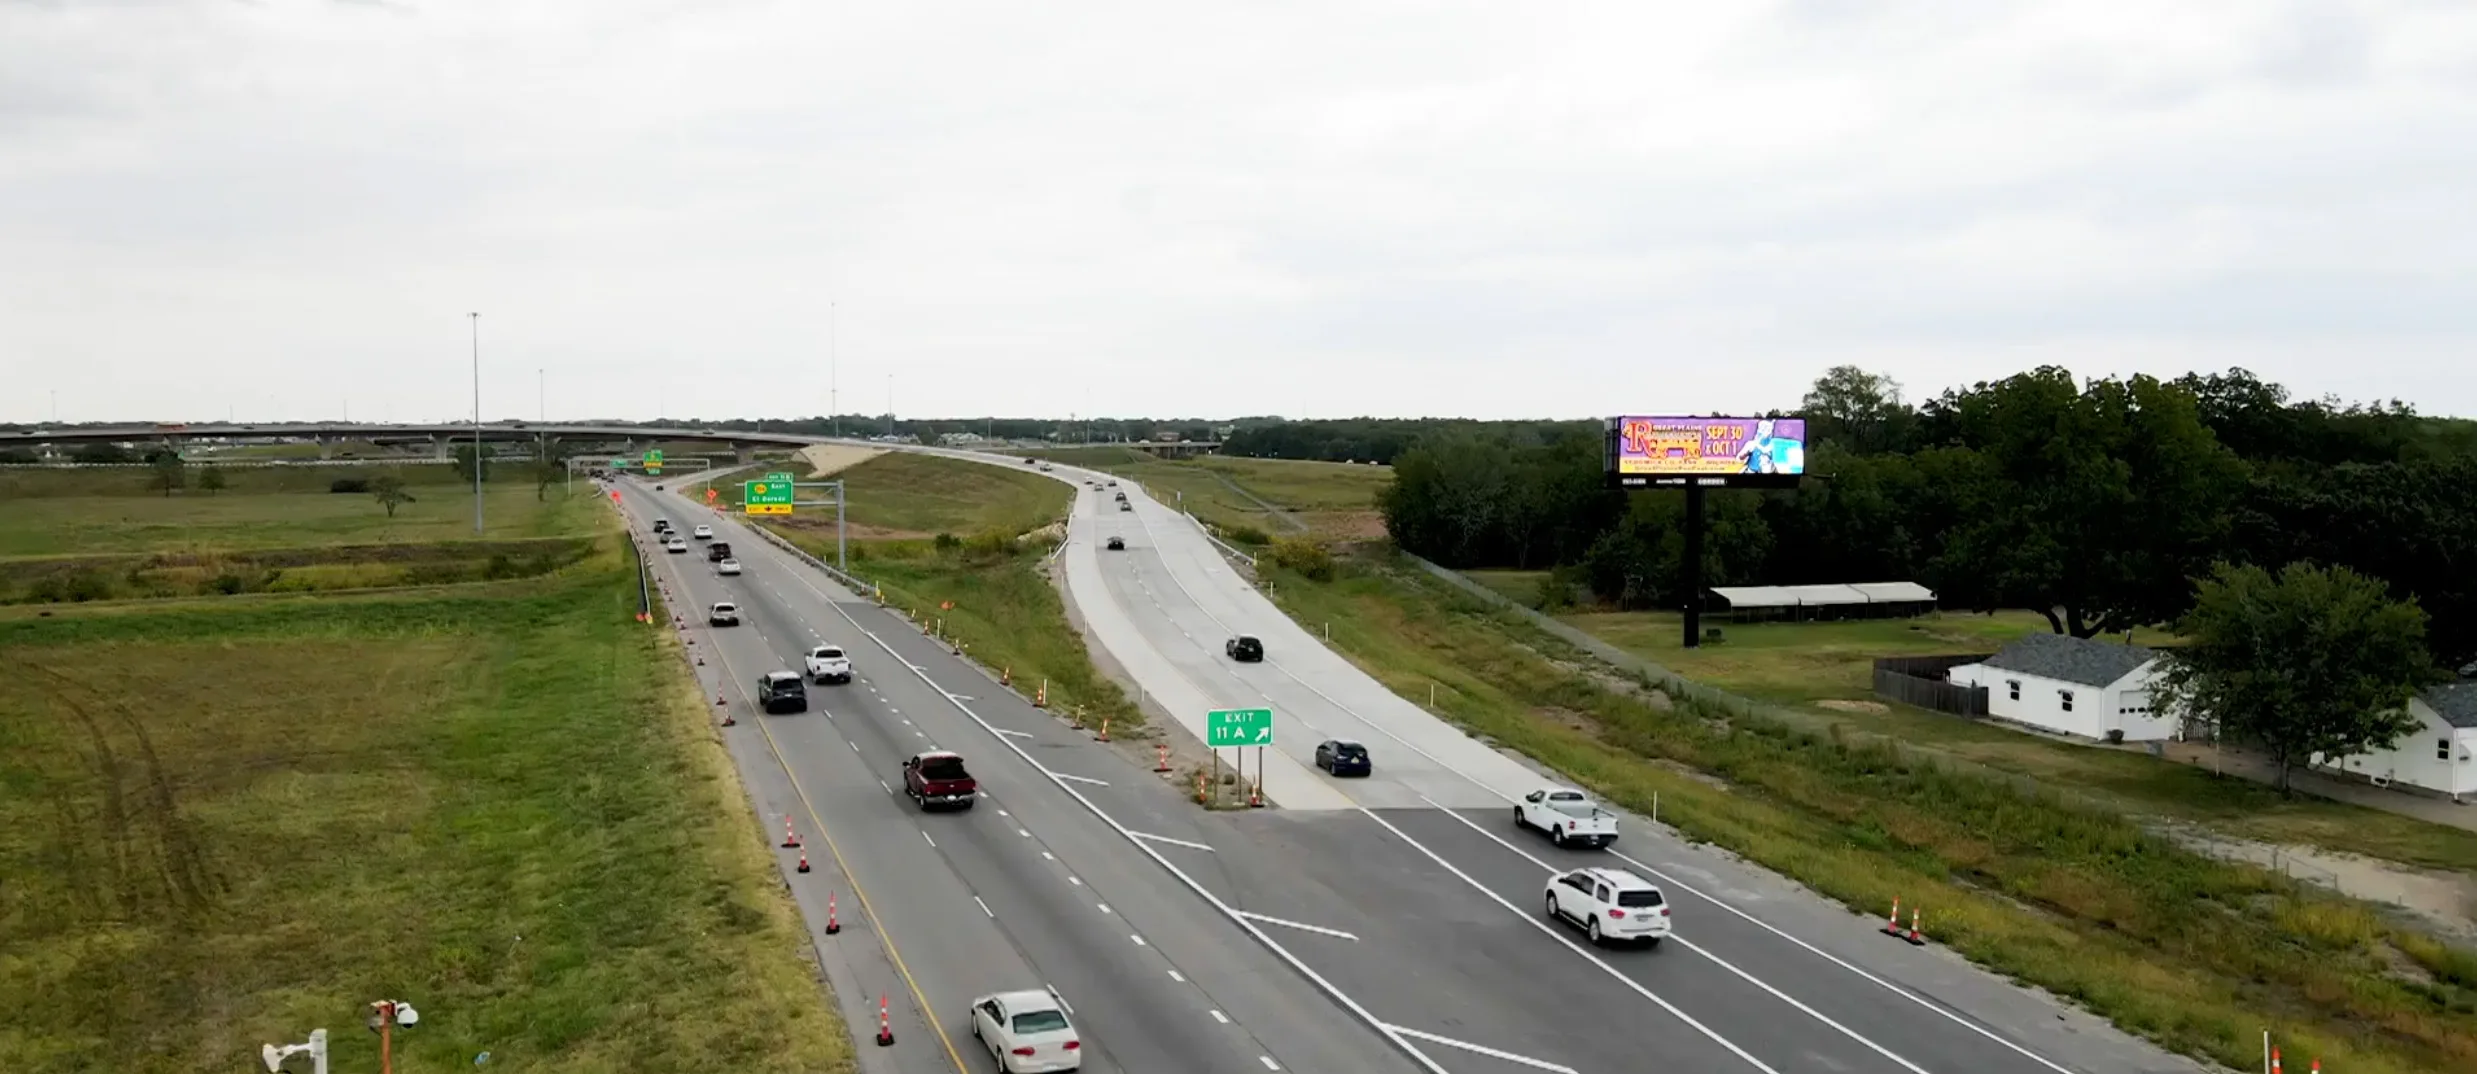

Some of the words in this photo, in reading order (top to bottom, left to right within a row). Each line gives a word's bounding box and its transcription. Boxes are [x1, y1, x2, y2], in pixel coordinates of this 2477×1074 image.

[1706, 425, 1728, 440] SEPT
[1730, 425, 1743, 440] 30
[1713, 440, 1730, 455] OCT
[1732, 440, 1737, 455] 1
[1225, 712, 1254, 723] EXIT
[1216, 726, 1227, 739] 11
[1233, 726, 1246, 739] A
